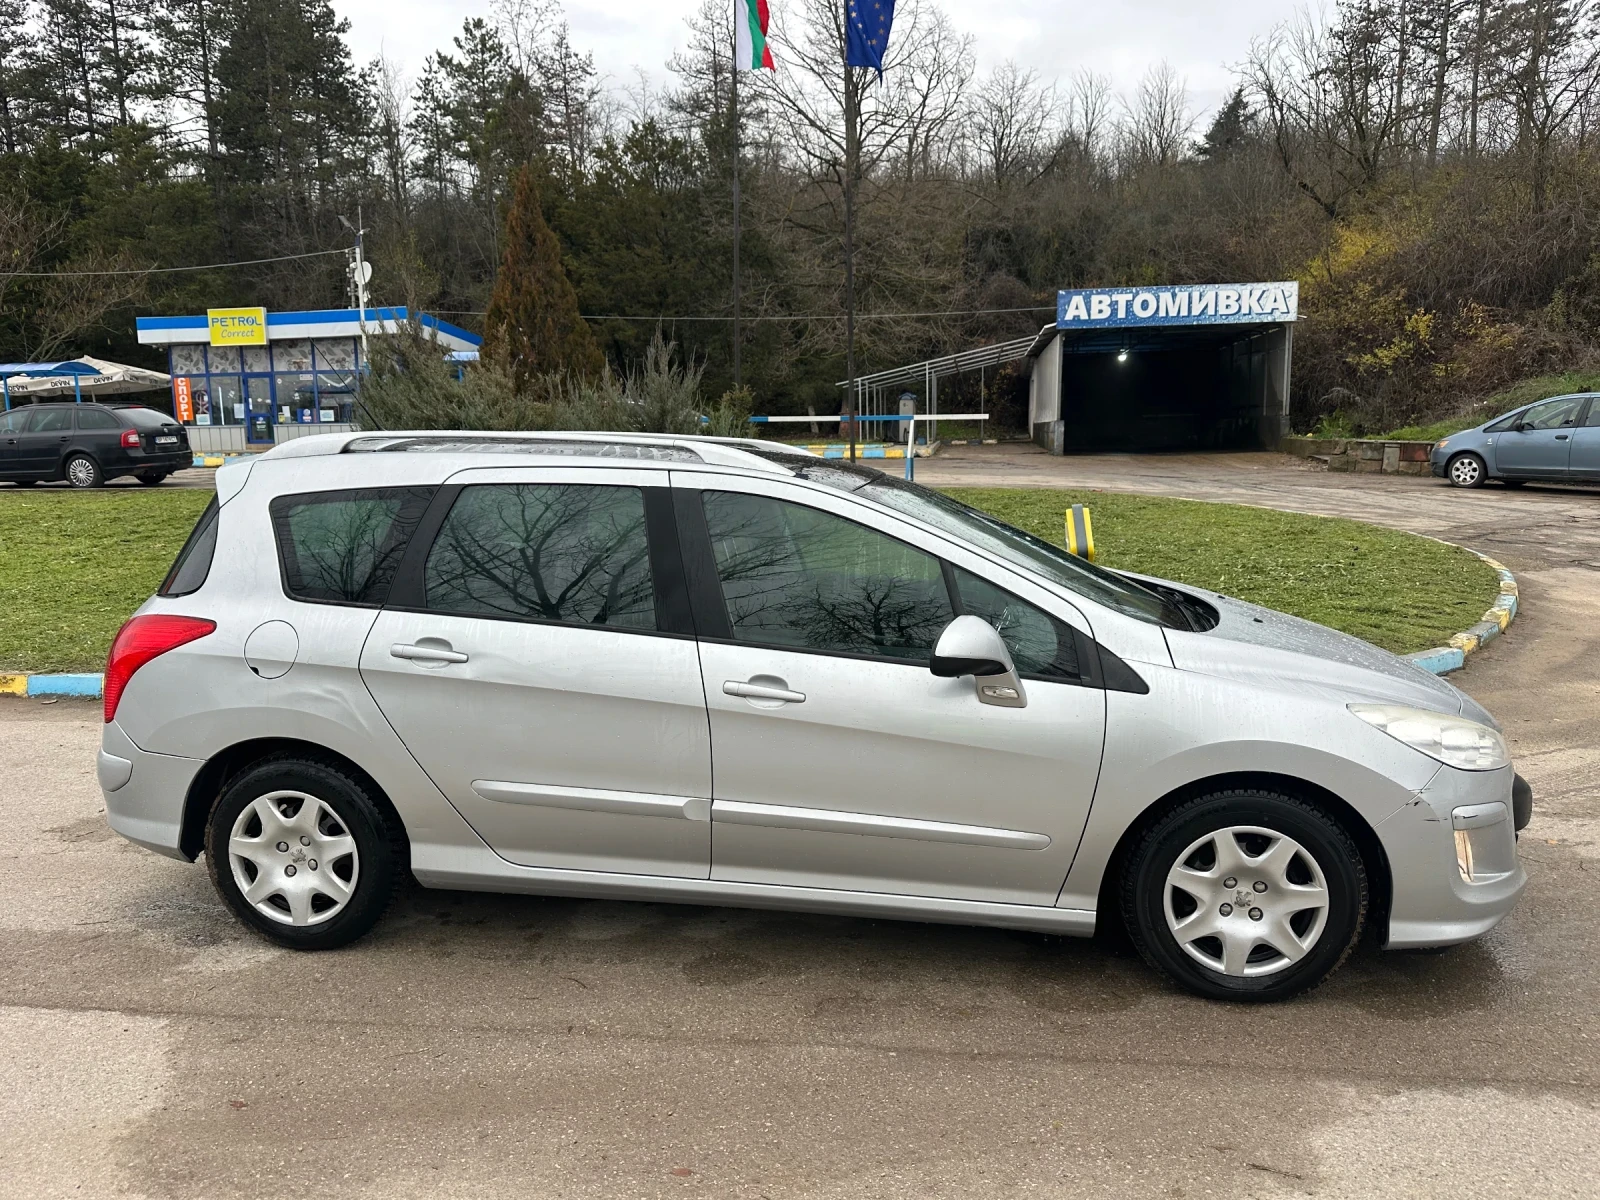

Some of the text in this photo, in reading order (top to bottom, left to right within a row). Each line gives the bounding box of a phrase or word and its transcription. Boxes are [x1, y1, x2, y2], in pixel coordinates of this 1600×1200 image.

[1064, 288, 1290, 321] АВТОМИВКА
[211, 316, 262, 327] PETROL
[221, 329, 255, 338] Correct
